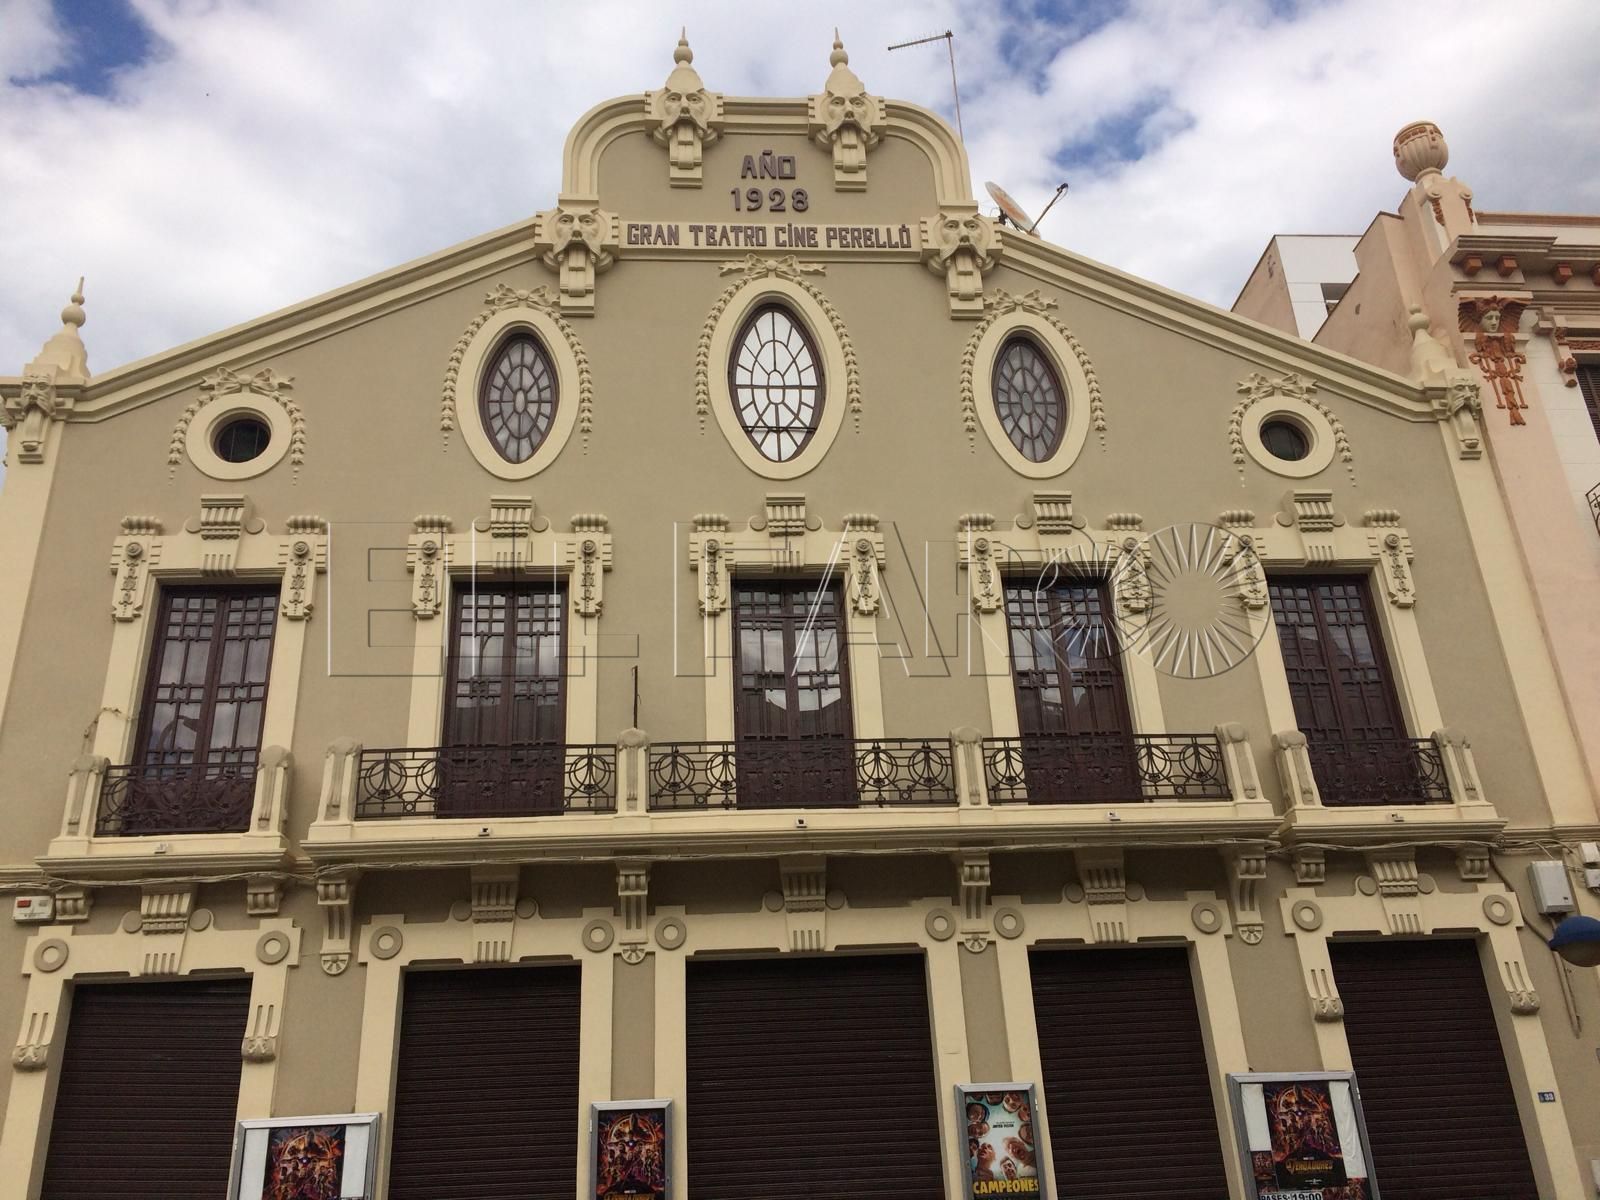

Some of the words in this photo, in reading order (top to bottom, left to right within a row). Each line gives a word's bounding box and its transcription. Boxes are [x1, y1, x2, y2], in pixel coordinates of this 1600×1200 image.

[741, 150, 796, 179] AÑO
[731, 187, 809, 211] 1928
[627, 223, 680, 246] GRAN
[689, 224, 767, 247] TEATRO
[973, 1179, 1039, 1194] CAMPEONES
